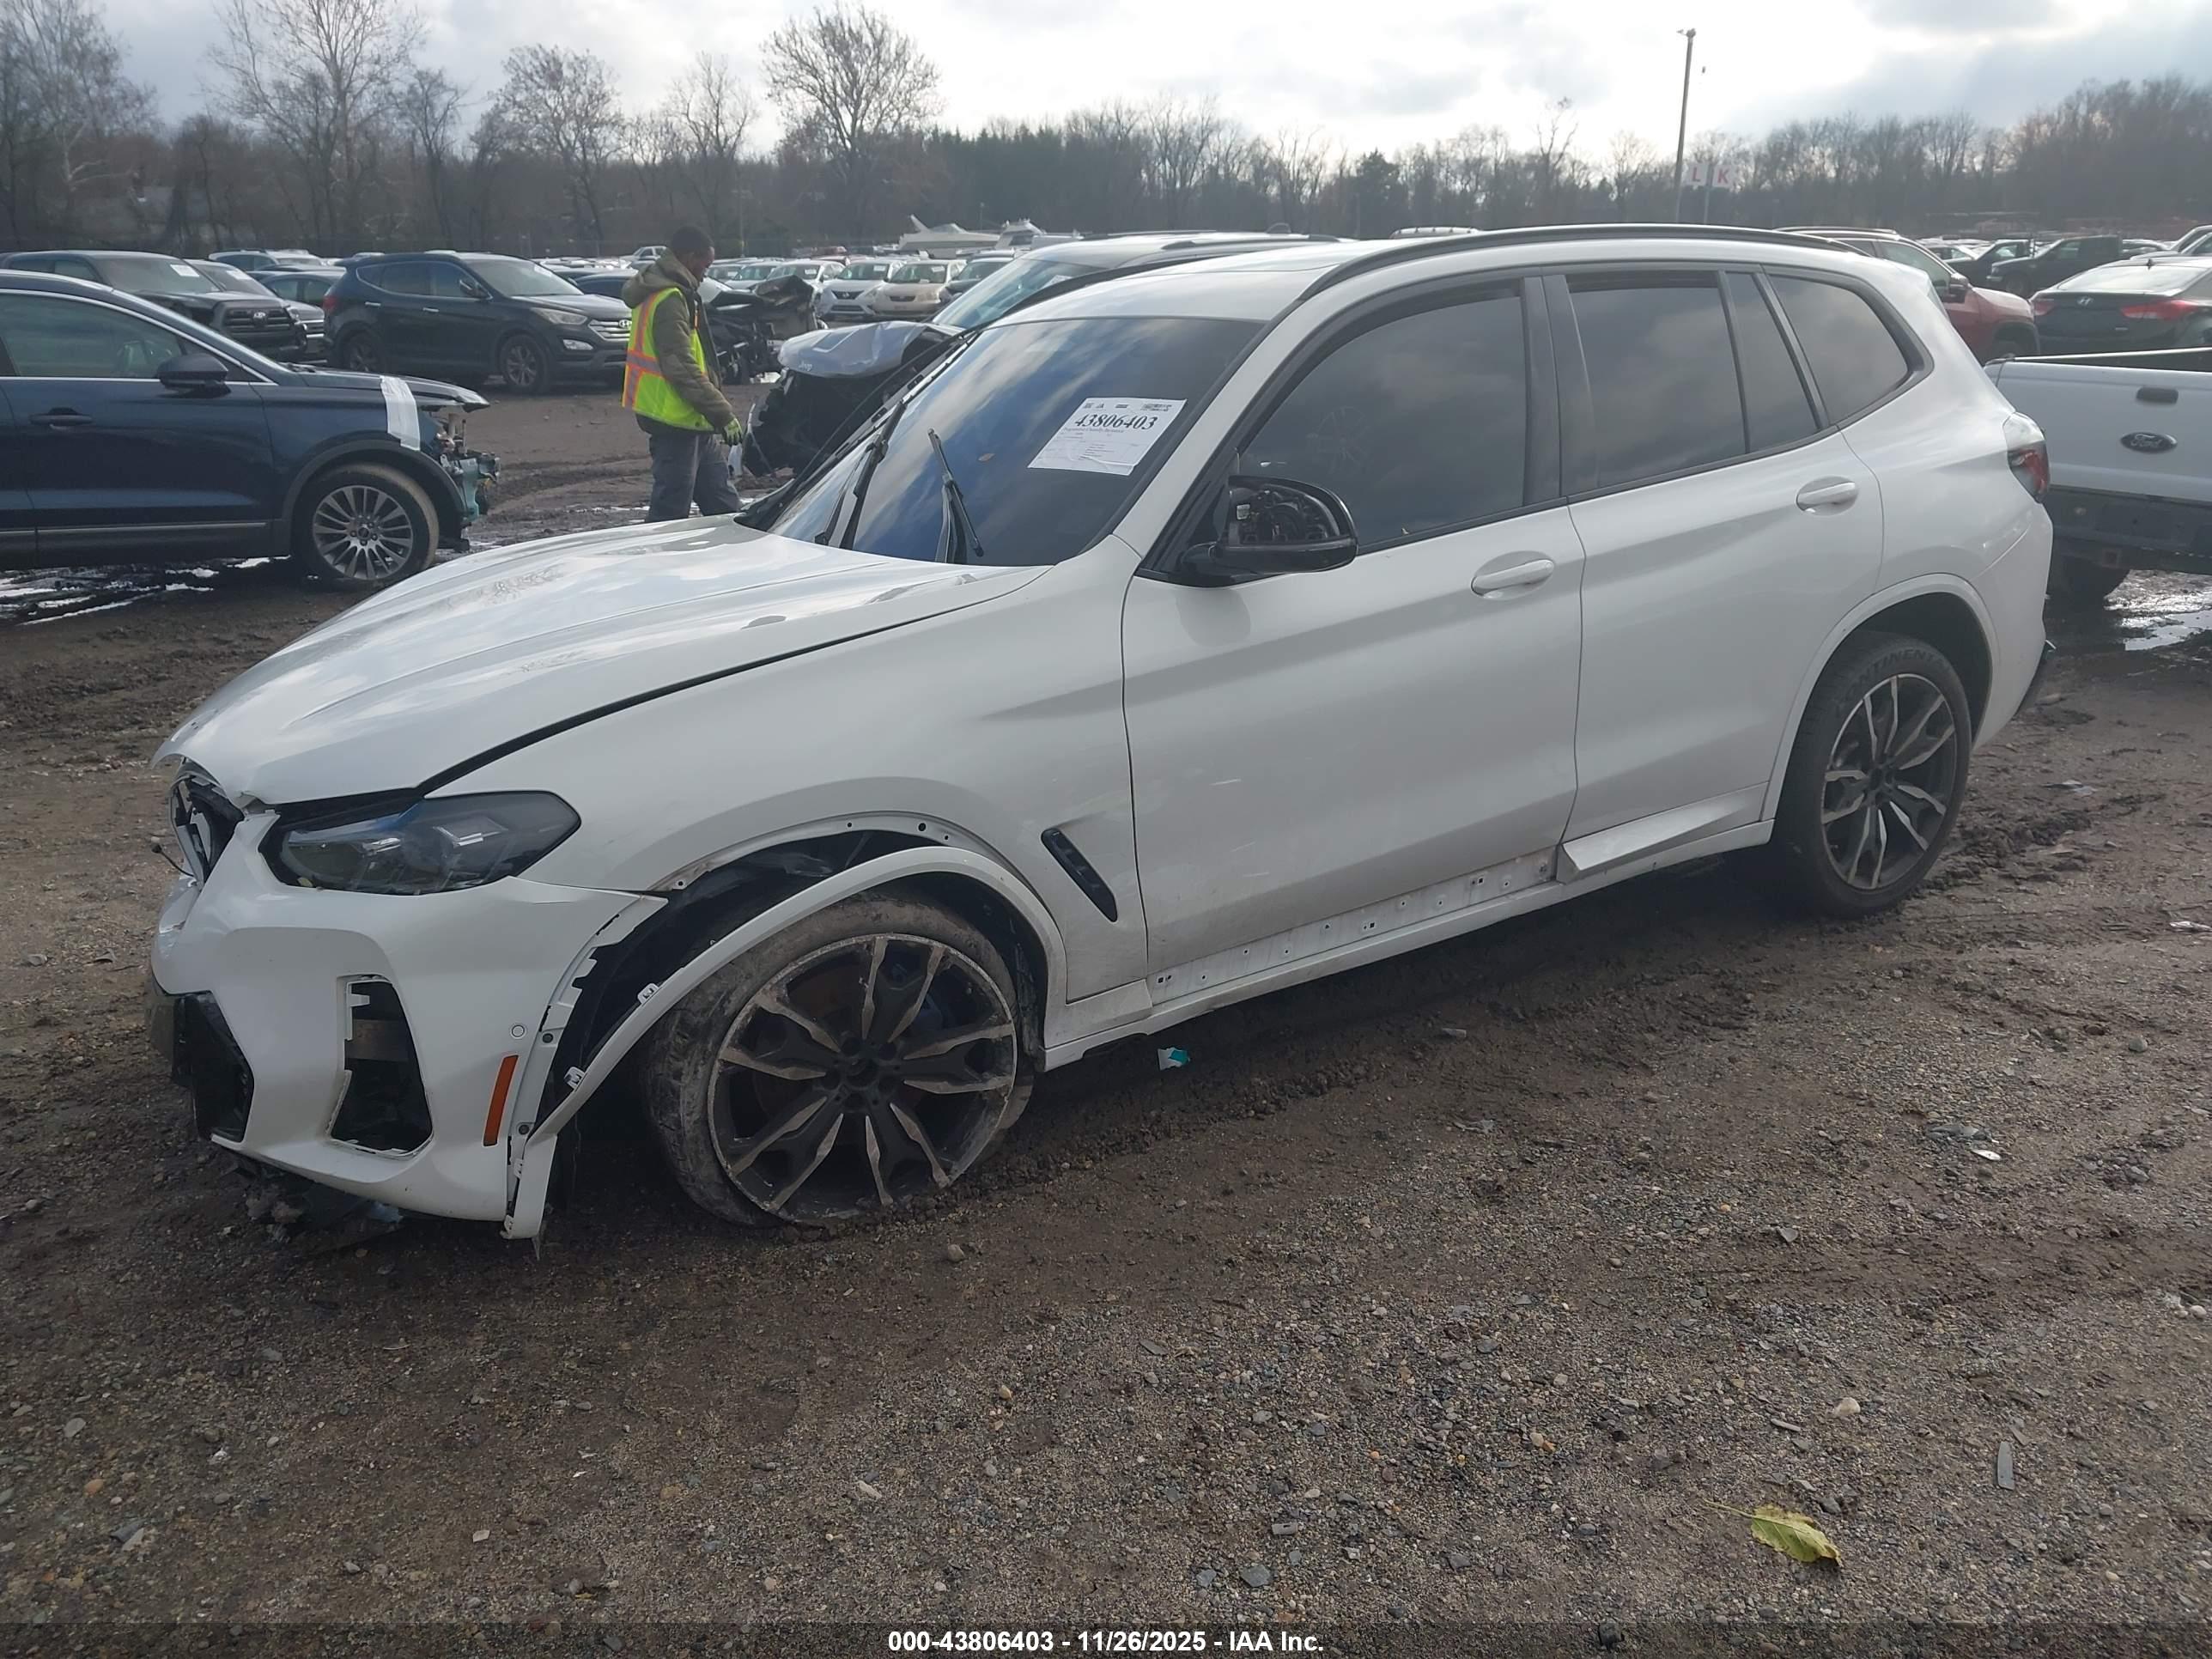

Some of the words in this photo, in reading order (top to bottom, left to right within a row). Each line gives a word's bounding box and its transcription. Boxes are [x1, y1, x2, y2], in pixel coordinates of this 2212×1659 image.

[1692, 167, 1701, 182] L
[1717, 167, 1730, 183] K
[1074, 413, 1158, 430] 43806403
[2130, 433, 2163, 447] Ford
